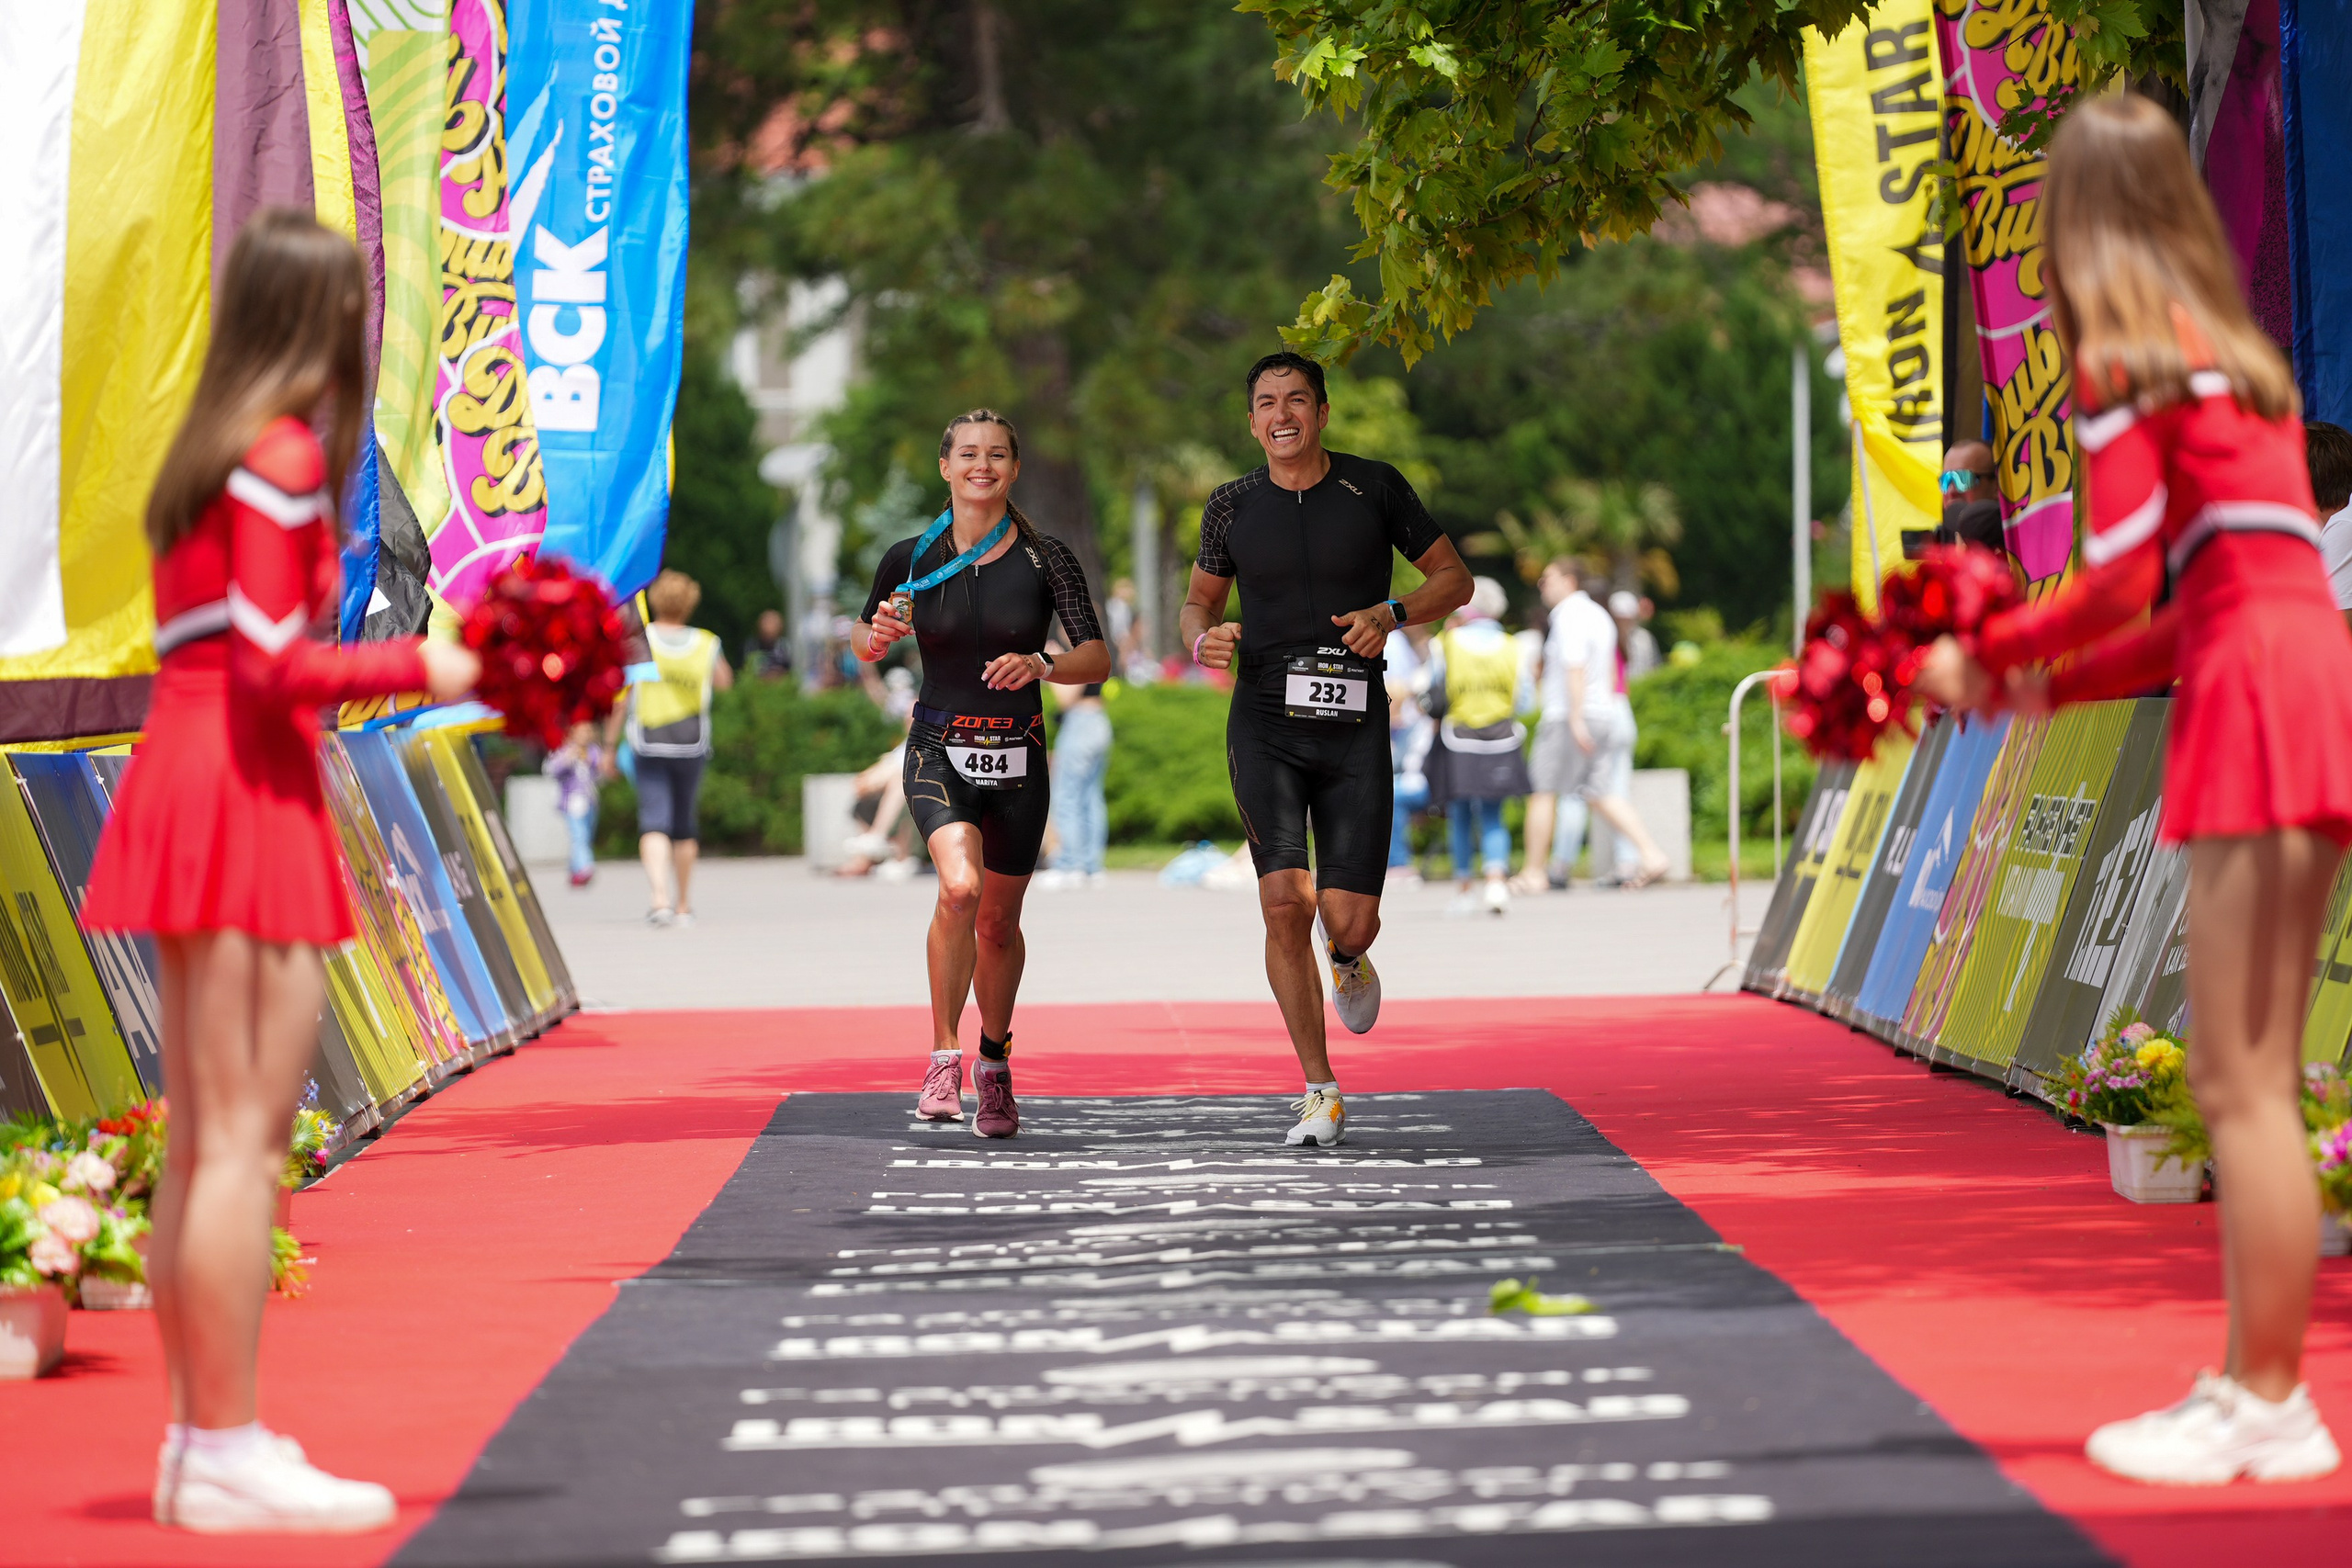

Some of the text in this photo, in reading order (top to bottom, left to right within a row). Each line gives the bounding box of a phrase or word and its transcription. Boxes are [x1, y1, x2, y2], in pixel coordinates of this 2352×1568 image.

[584, 17, 623, 223] СТРАХОВОЙ
[1864, 19, 1939, 205] STAR
[526, 222, 609, 433] ВСК
[1338, 478, 1363, 495] 2XU
[1024, 547, 1042, 569] 2XU
[1317, 647, 1347, 656] 2XU
[1308, 682, 1347, 705] 232
[1316, 708, 1339, 716] RUSLAN
[952, 715, 1014, 729] ZONE3
[965, 753, 1009, 774] 484
[976, 778, 998, 786] MARIYA
[892, 1157, 1484, 1168] IRON STAR
